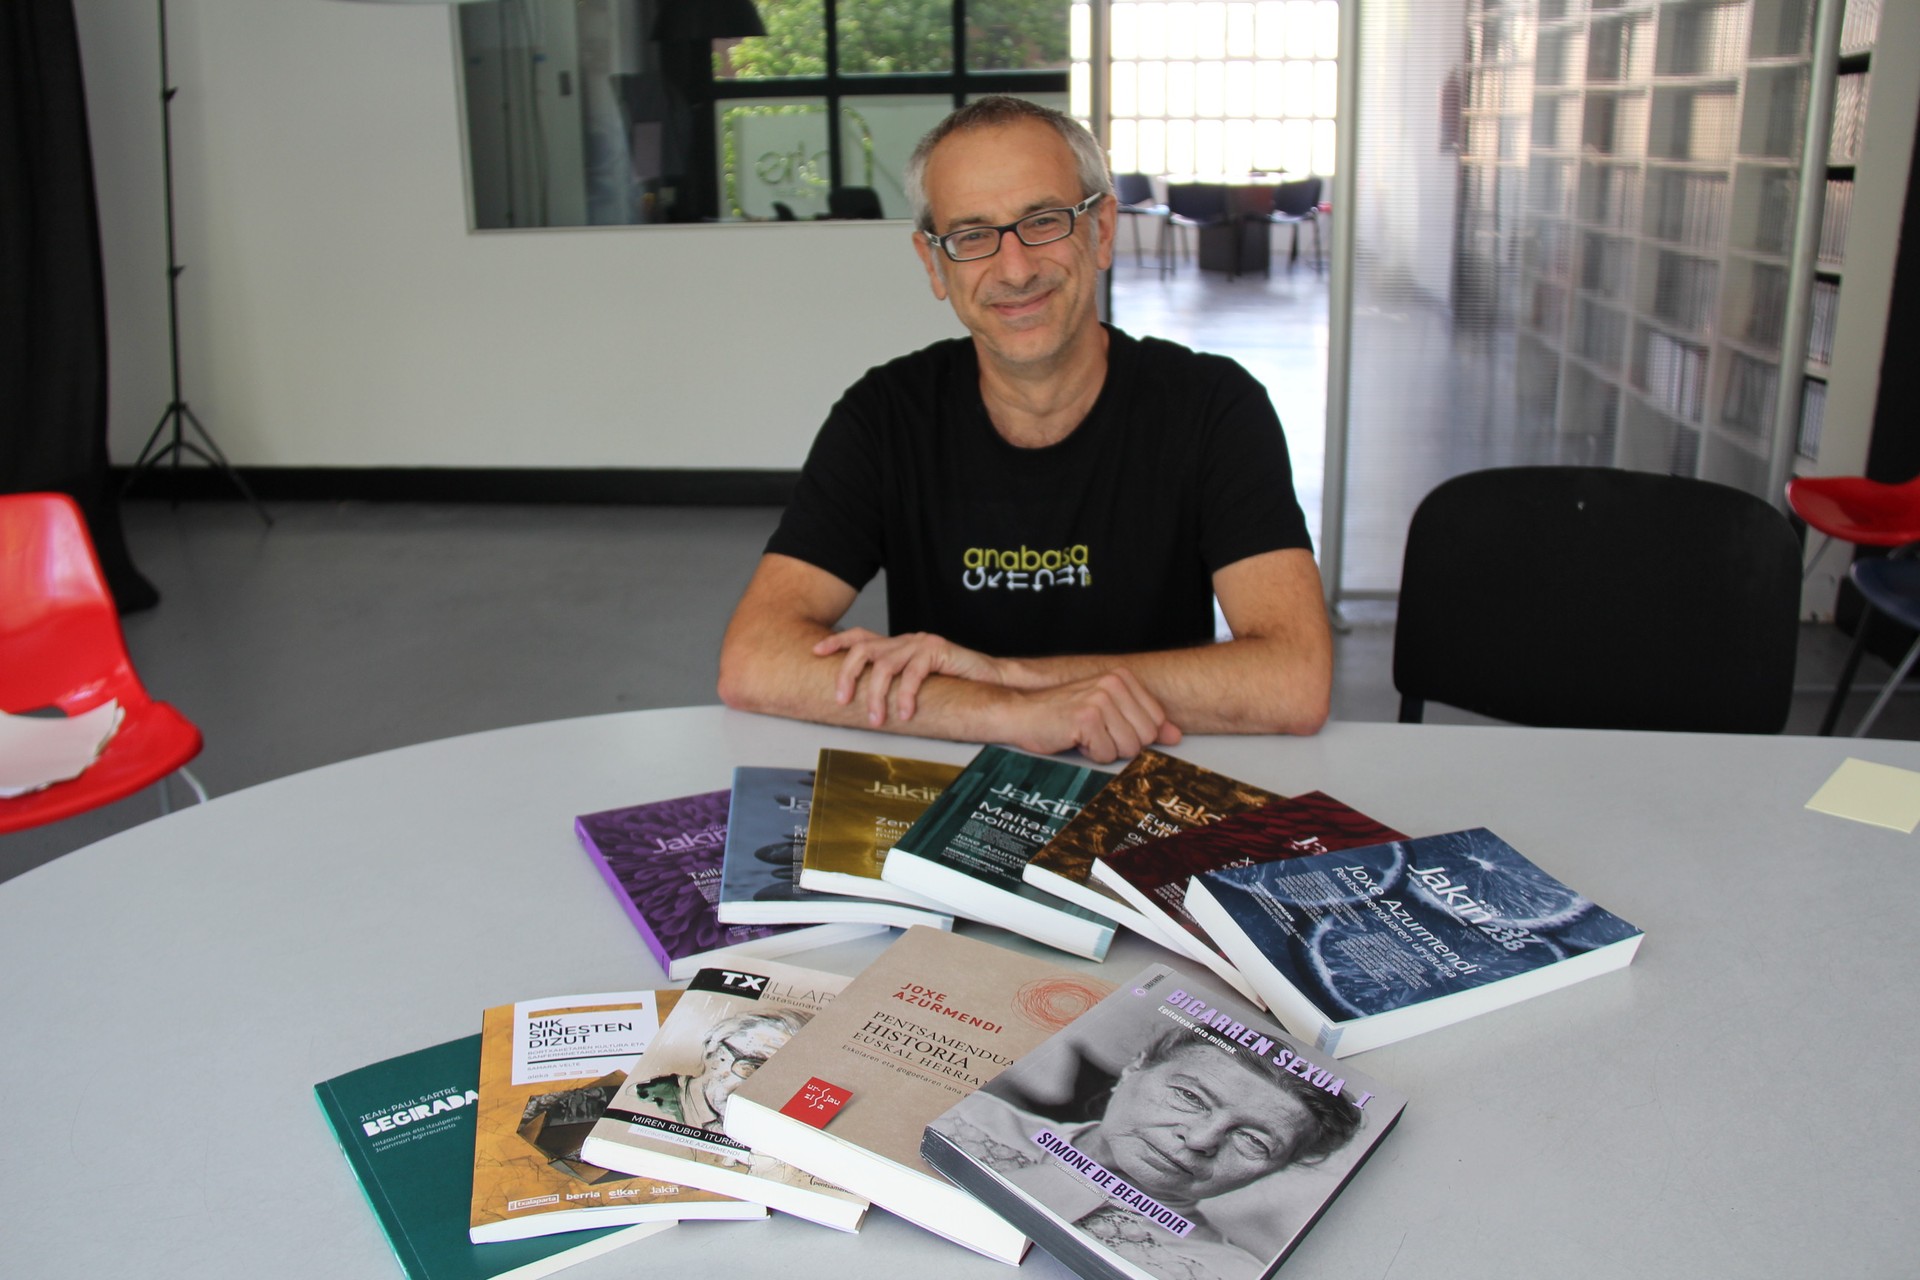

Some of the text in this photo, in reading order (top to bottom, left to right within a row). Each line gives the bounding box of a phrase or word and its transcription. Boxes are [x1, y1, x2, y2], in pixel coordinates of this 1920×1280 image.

[990, 783, 1083, 816] Jakin
[970, 811, 1052, 845] politiko
[1144, 812, 1182, 834] Eusk
[982, 844, 1027, 865] Azurme
[1332, 867, 1413, 942] Pentsamenduaren
[1407, 863, 1492, 924] Jakin
[1345, 865, 1385, 896] Joxe
[1380, 899, 1482, 975] Azurmendi
[1479, 924, 1526, 951] 238
[721, 972, 836, 1004] TXILLAR
[762, 993, 823, 1011] Batasunare
[900, 982, 948, 1003] JOXE
[529, 1018, 563, 1030] NIK
[892, 991, 1004, 1035] AZURMENDI
[529, 1022, 633, 1039] SINESTEN
[529, 1034, 590, 1048] DIZUT
[861, 1020, 969, 1070] HISTORIA
[872, 1011, 1015, 1068] PENTSAMENDUA
[1194, 1027, 1208, 1038] eta
[1208, 1034, 1237, 1054] mitoak
[842, 1044, 962, 1095] Eskolaren eta gogoetaren lana
[853, 1031, 988, 1086] EUSKAL HERRIA
[1273, 1049, 1347, 1097] SEXUA
[360, 1086, 459, 1123] JEAN-PAUL SARTRE
[363, 1089, 479, 1137] BEGIRADA
[412, 1126, 425, 1136] eta
[631, 1114, 666, 1128] MIREN
[668, 1124, 702, 1138] RUBIO
[566, 1191, 600, 1200] berria
[608, 1188, 641, 1197] elkar
[1037, 1132, 1190, 1234] SIMONE DE BEAUVOIR
